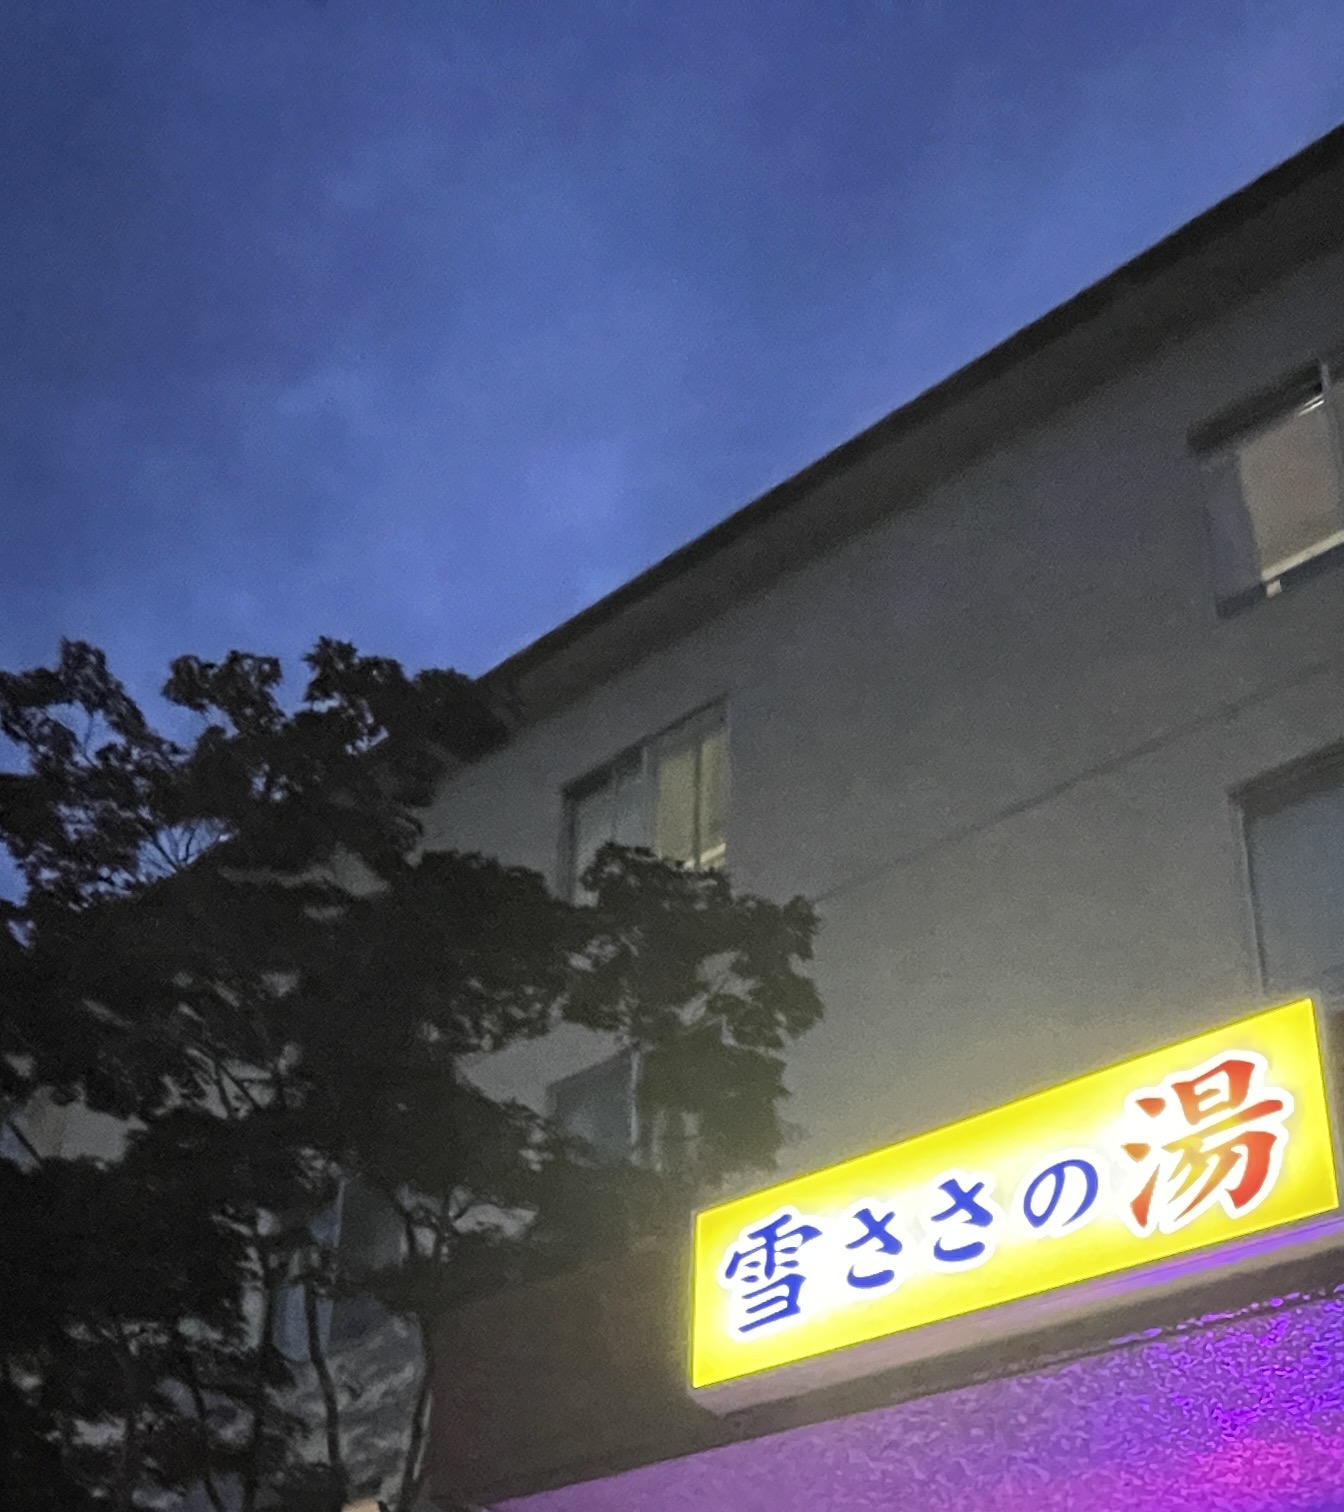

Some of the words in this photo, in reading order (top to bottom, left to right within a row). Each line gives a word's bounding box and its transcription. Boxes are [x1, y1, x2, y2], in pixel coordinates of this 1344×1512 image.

[724, 1058, 1283, 1333] 雪ささの湯
